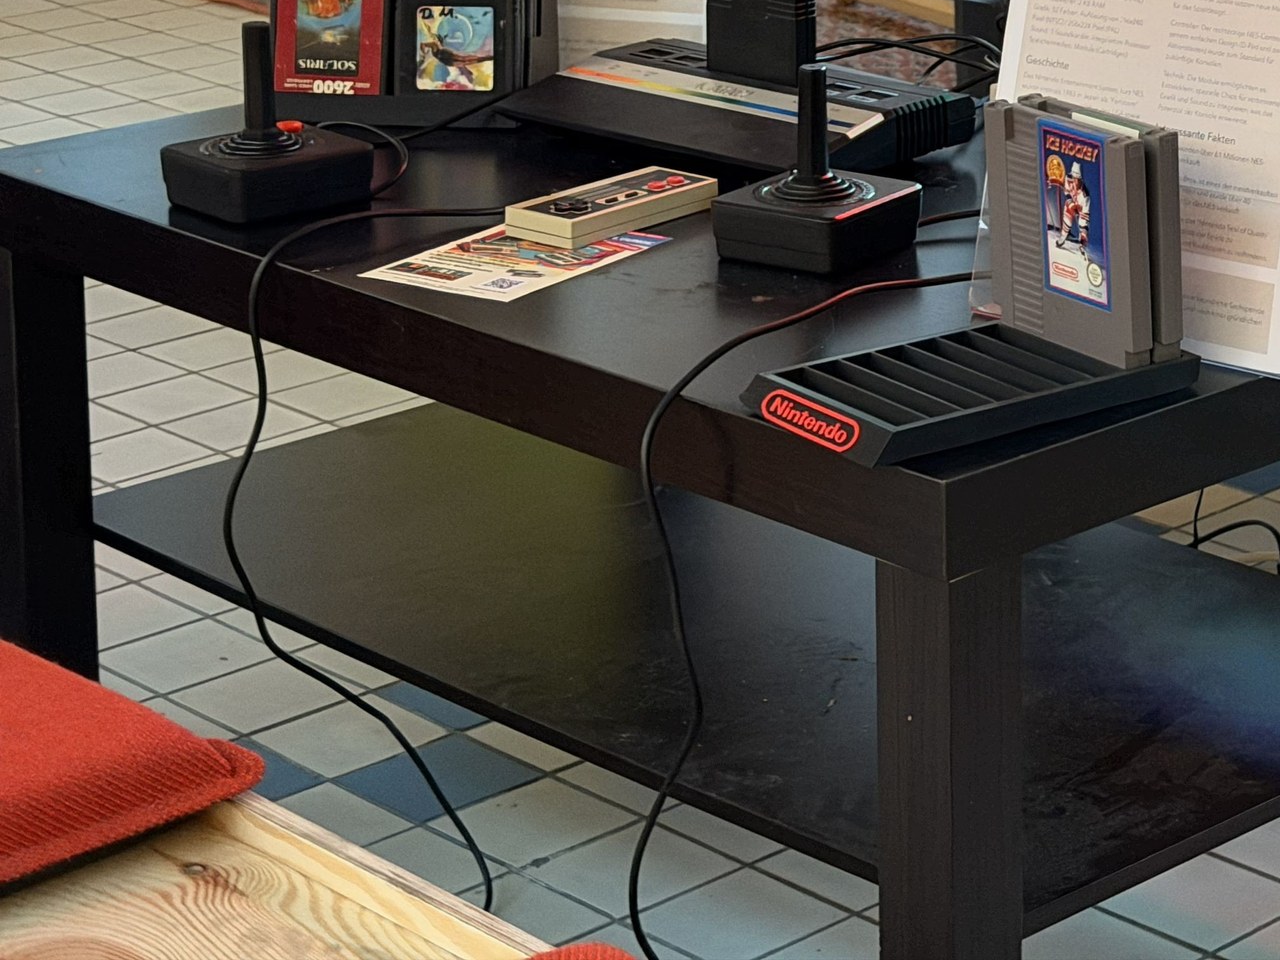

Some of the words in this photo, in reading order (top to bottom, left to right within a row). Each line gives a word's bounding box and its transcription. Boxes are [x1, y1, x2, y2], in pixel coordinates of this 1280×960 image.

[297, 58, 358, 71] SOLARIS
[1025, 54, 1069, 69] Geschichte
[313, 79, 355, 95] 2600
[1208, 132, 1236, 145] Fakten
[1061, 139, 1098, 162] HOCKEY
[769, 396, 848, 443] Nintendo
